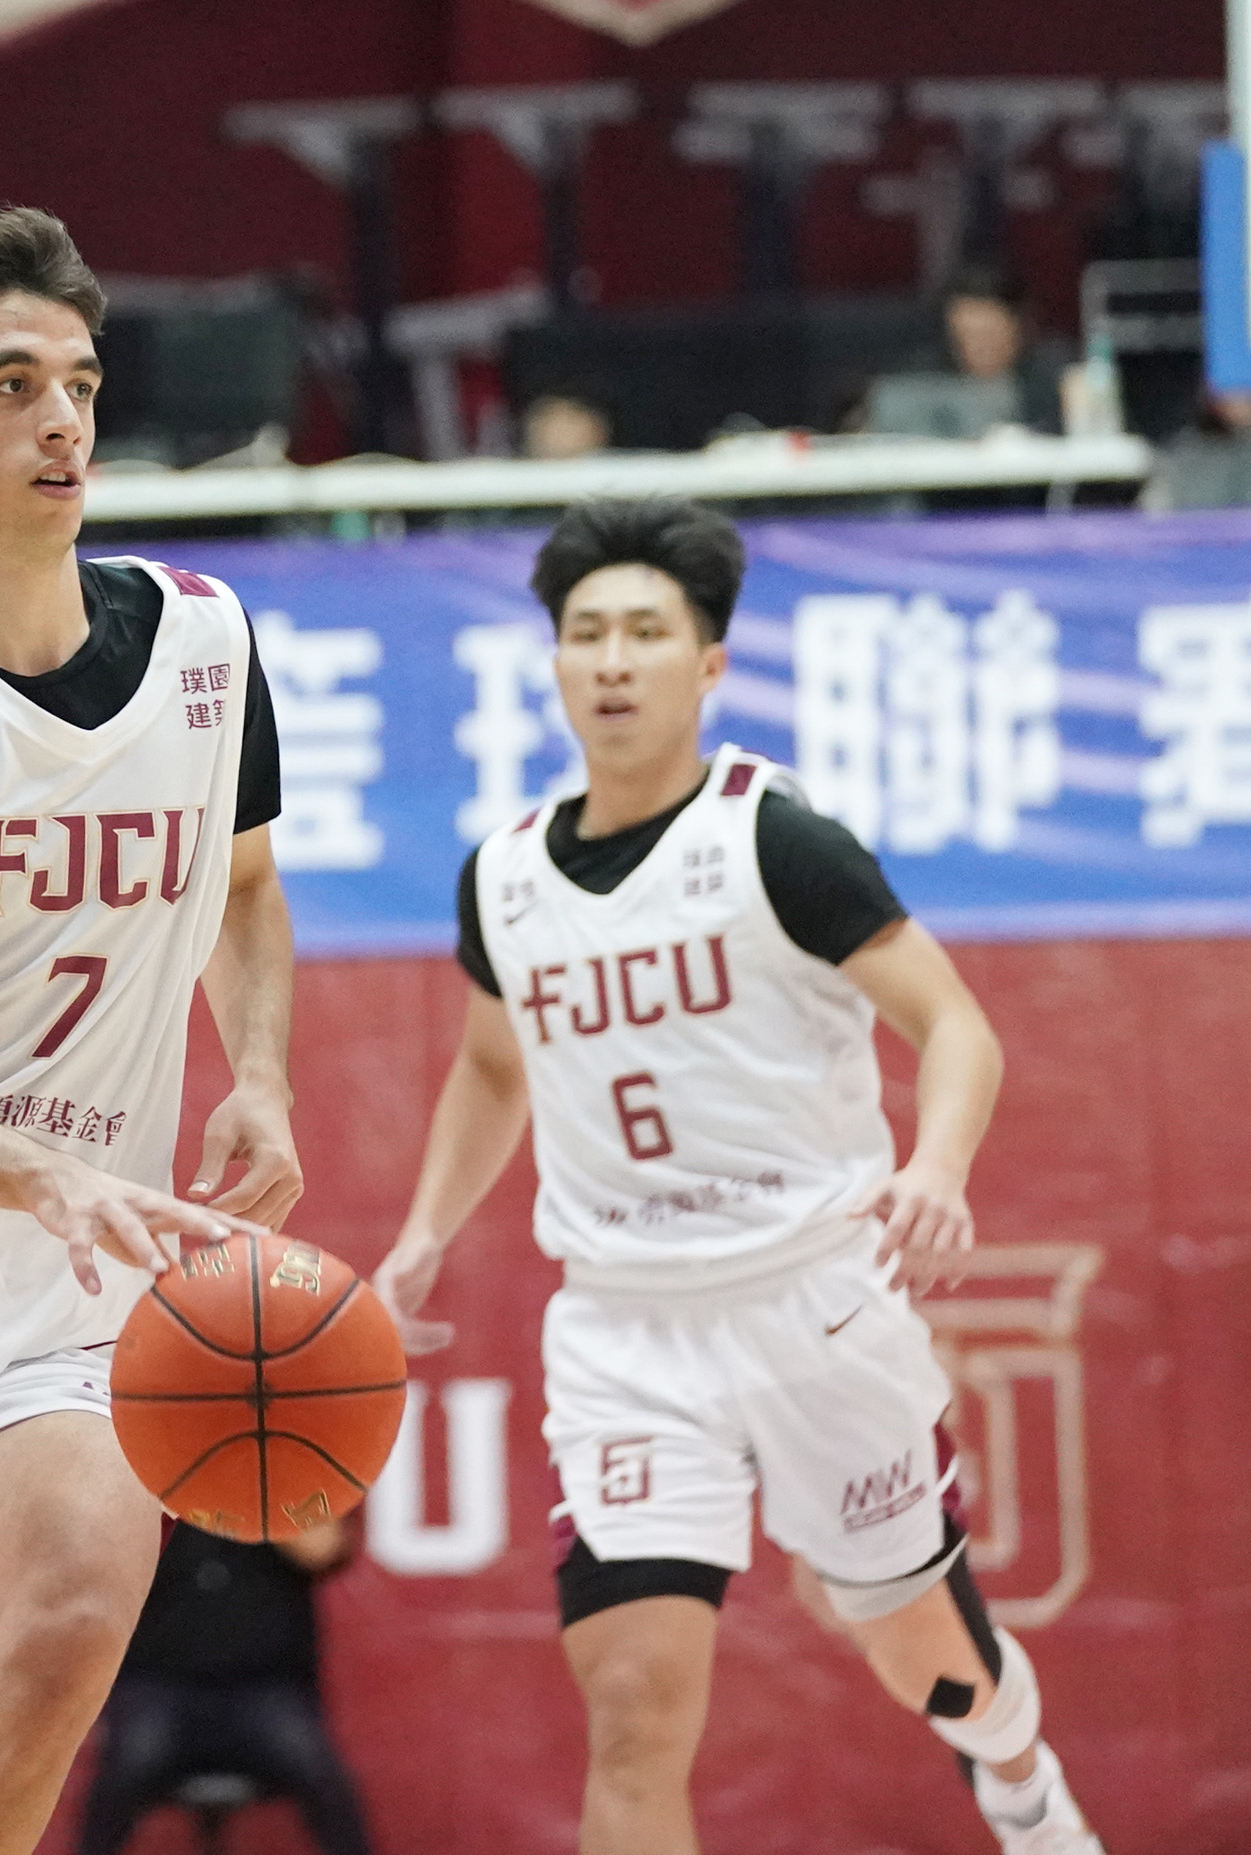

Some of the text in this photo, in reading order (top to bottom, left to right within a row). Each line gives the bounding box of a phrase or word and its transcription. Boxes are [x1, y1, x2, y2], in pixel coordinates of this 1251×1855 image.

[180, 663, 230, 695] 璞園
[31, 952, 108, 1060] 7
[521, 934, 734, 1046] FJCU
[612, 1072, 674, 1161] 6
